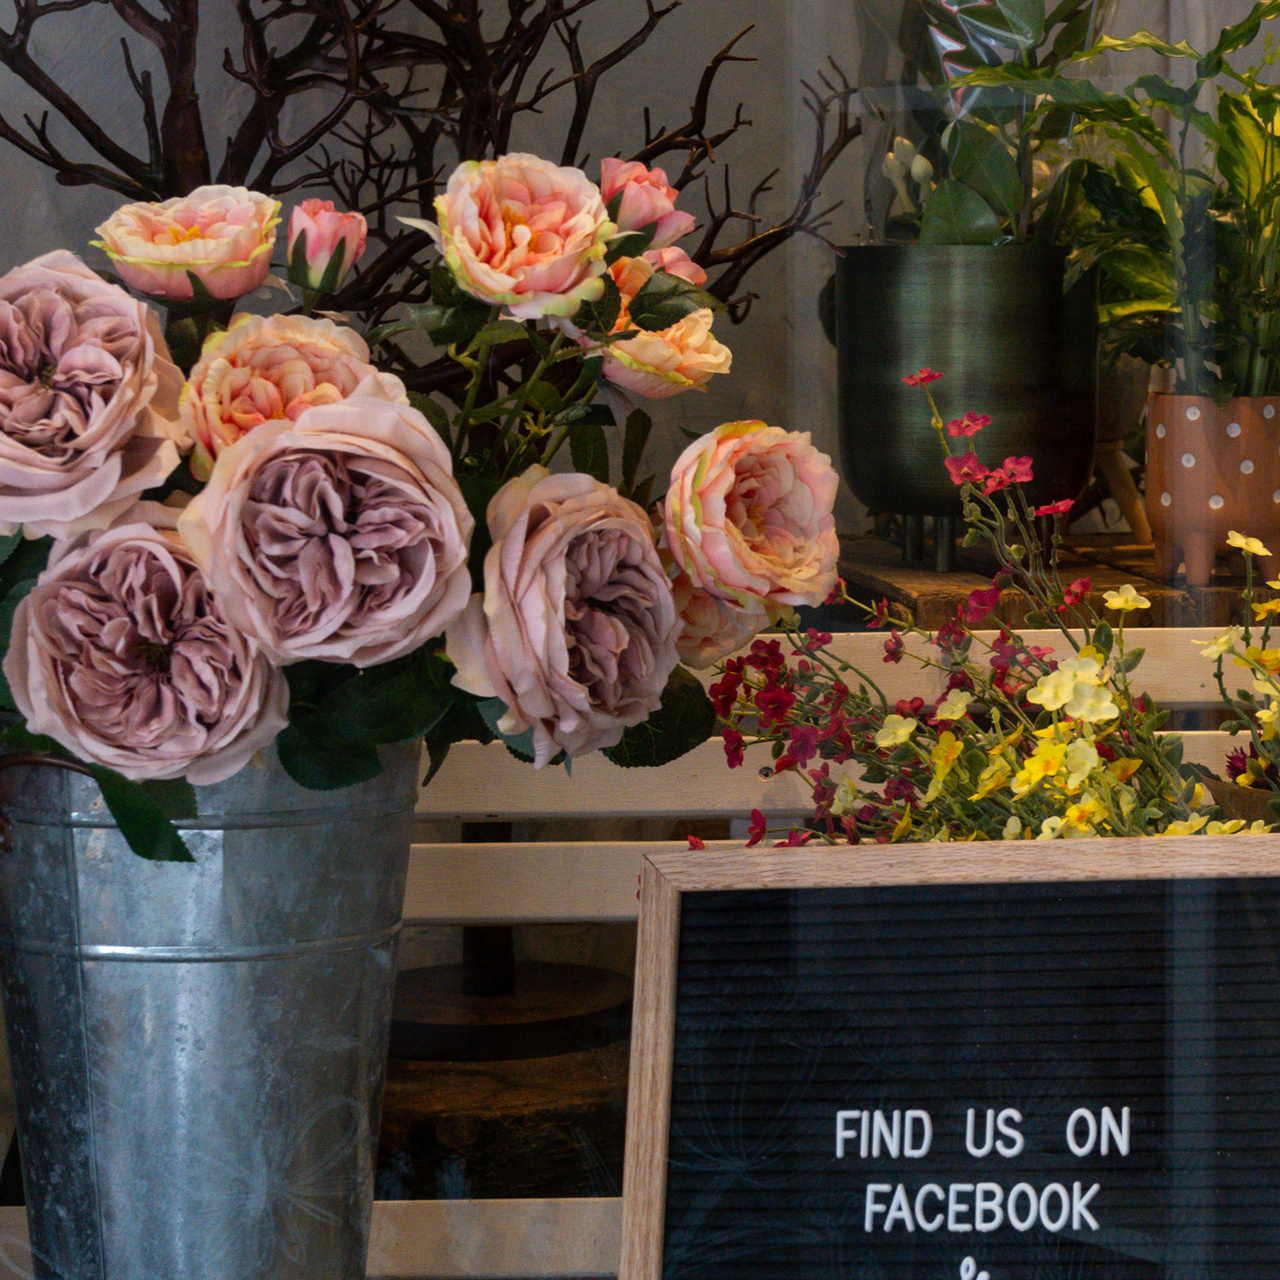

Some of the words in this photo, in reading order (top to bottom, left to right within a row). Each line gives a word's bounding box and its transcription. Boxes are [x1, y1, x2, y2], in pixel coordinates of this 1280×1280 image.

[835, 1108, 933, 1159] FIND
[964, 1107, 1025, 1159] US
[1065, 1105, 1131, 1158] ON
[863, 1180, 1101, 1234] FACEBOOK
